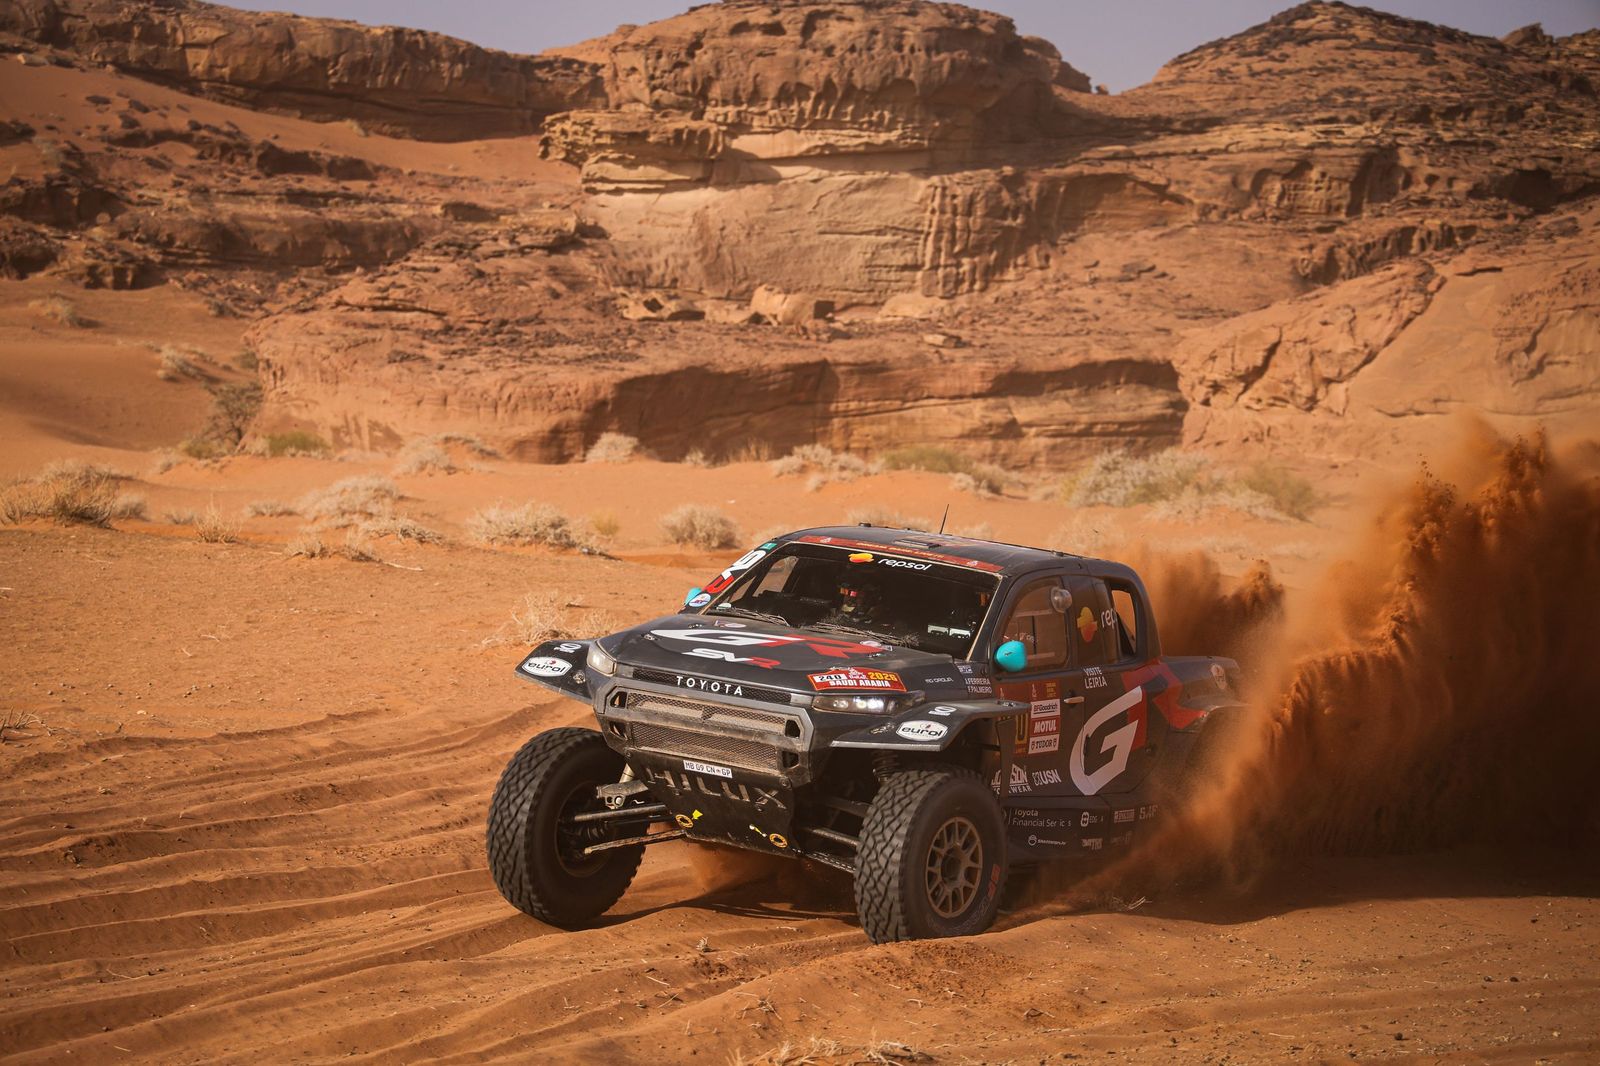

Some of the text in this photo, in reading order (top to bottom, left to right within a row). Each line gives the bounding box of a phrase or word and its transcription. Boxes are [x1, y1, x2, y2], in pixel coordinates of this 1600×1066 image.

[878, 557, 933, 571] repsol
[527, 662, 566, 673] eurol
[1083, 666, 1103, 677] VISITE
[676, 676, 744, 696] TOYOTA
[829, 679, 891, 688] SAUDI ARABIA
[1084, 676, 1108, 689] LEIRIA
[1033, 703, 1058, 712] BFGoodrich
[901, 726, 944, 737] eurol
[1034, 719, 1057, 734] MOTUL
[1035, 739, 1053, 750] TUDOR
[706, 765, 716, 774] CN
[1040, 768, 1062, 786] USN
[1012, 817, 1072, 828] Financial Serics
